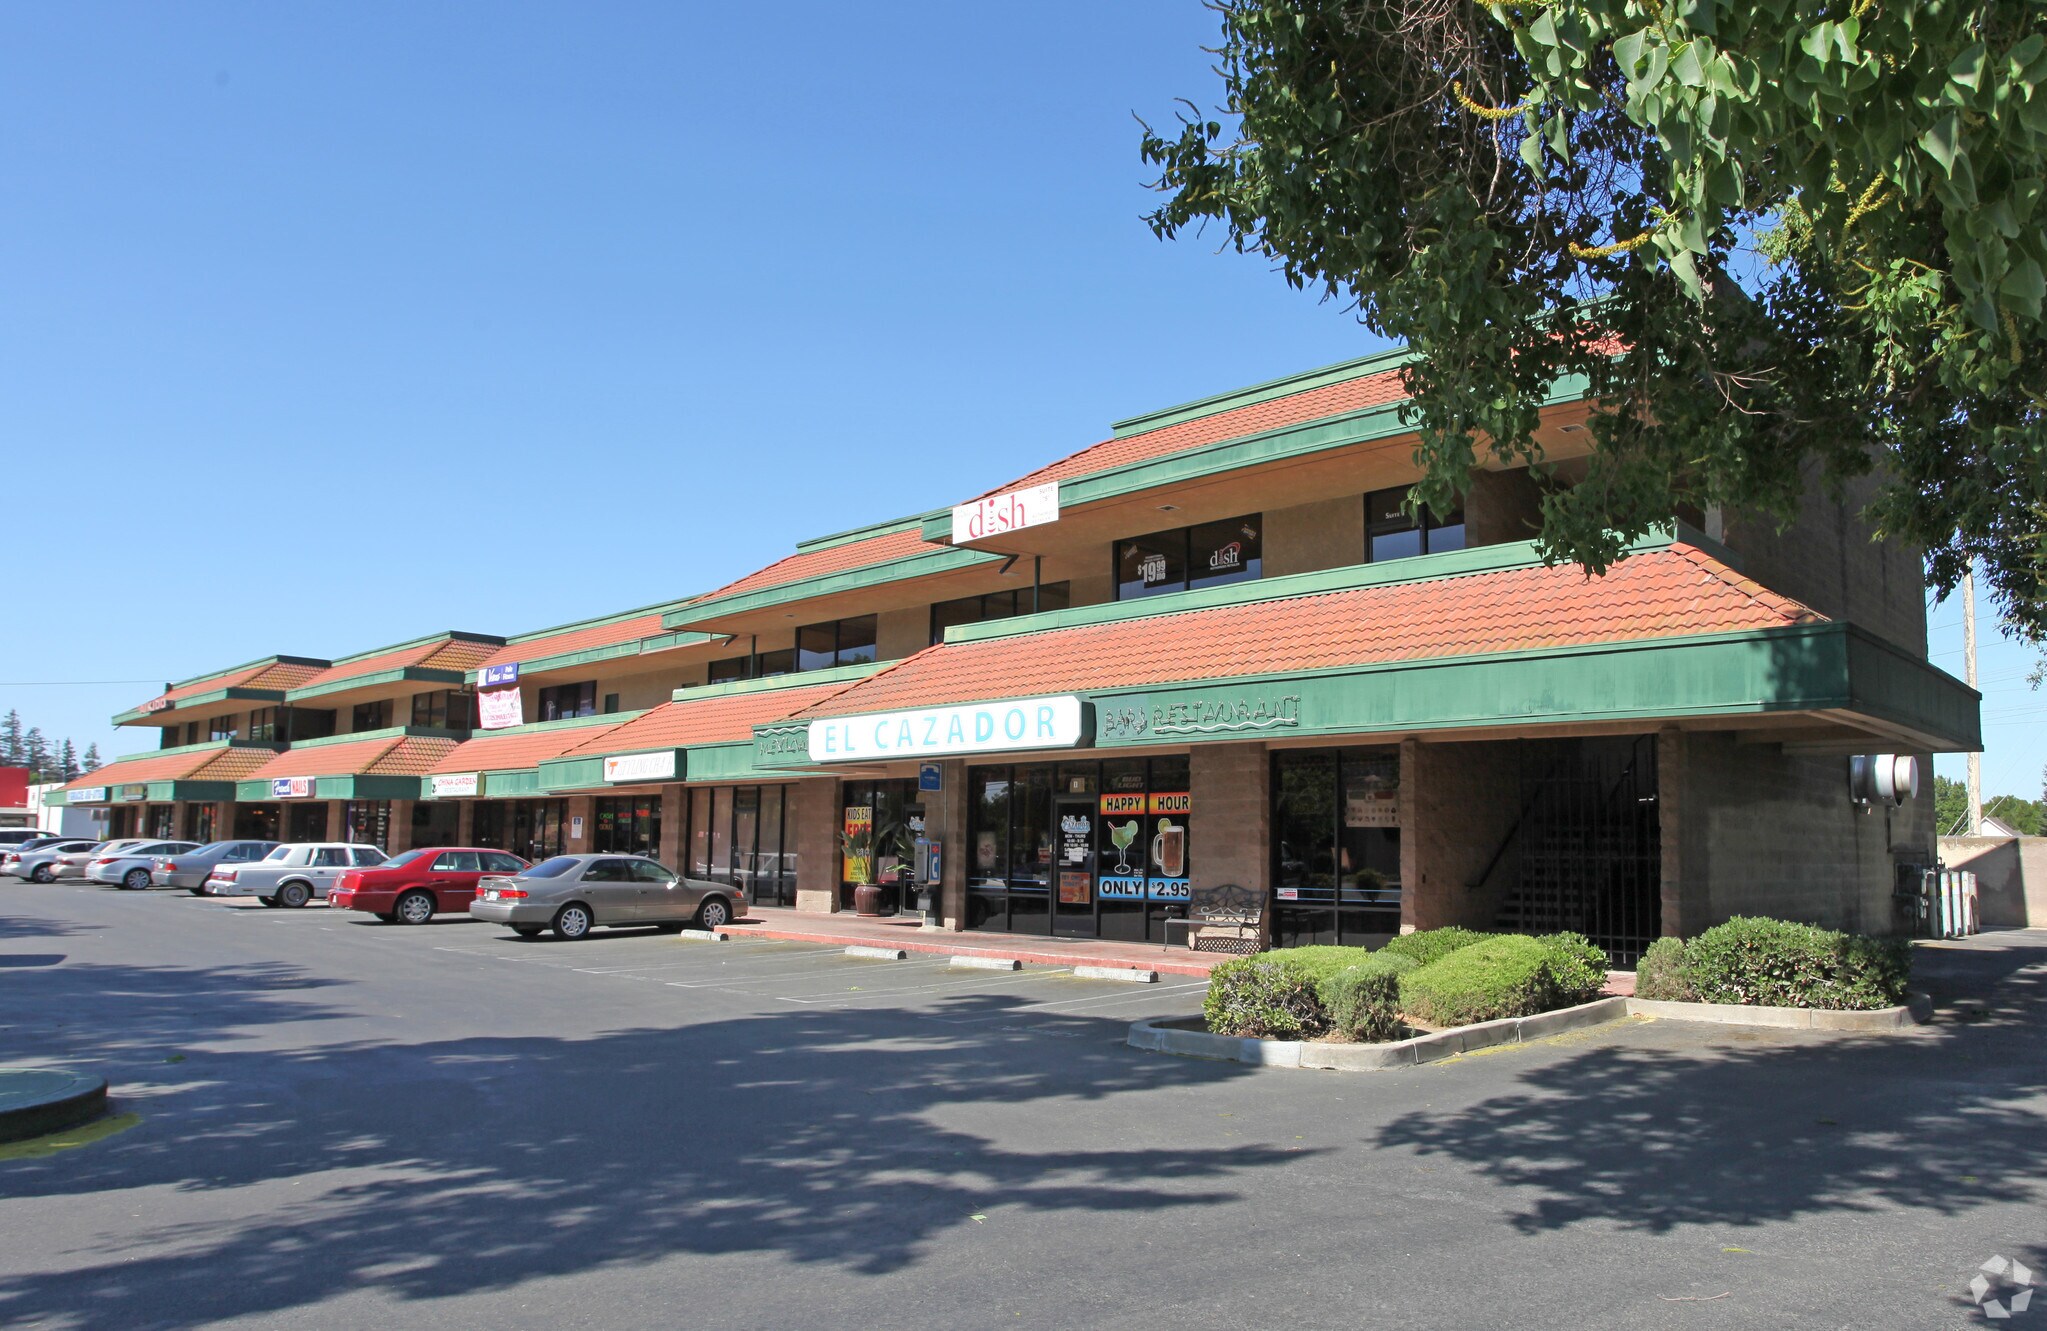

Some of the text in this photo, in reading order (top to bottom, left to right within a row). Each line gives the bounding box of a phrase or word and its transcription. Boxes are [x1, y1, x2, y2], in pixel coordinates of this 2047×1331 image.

[969, 494, 1026, 538] dish
[1209, 548, 1238, 566] dish
[1153, 695, 1300, 725] RESTAURANT
[825, 706, 1055, 752] EL CAZADOR
[292, 780, 307, 793] NAILS
[455, 777, 477, 786] GARDEN
[1106, 796, 1189, 811] HAPPY HOUR
[847, 808, 871, 820] KIDS EAT
[1102, 880, 1190, 897] ONLY $2.95
